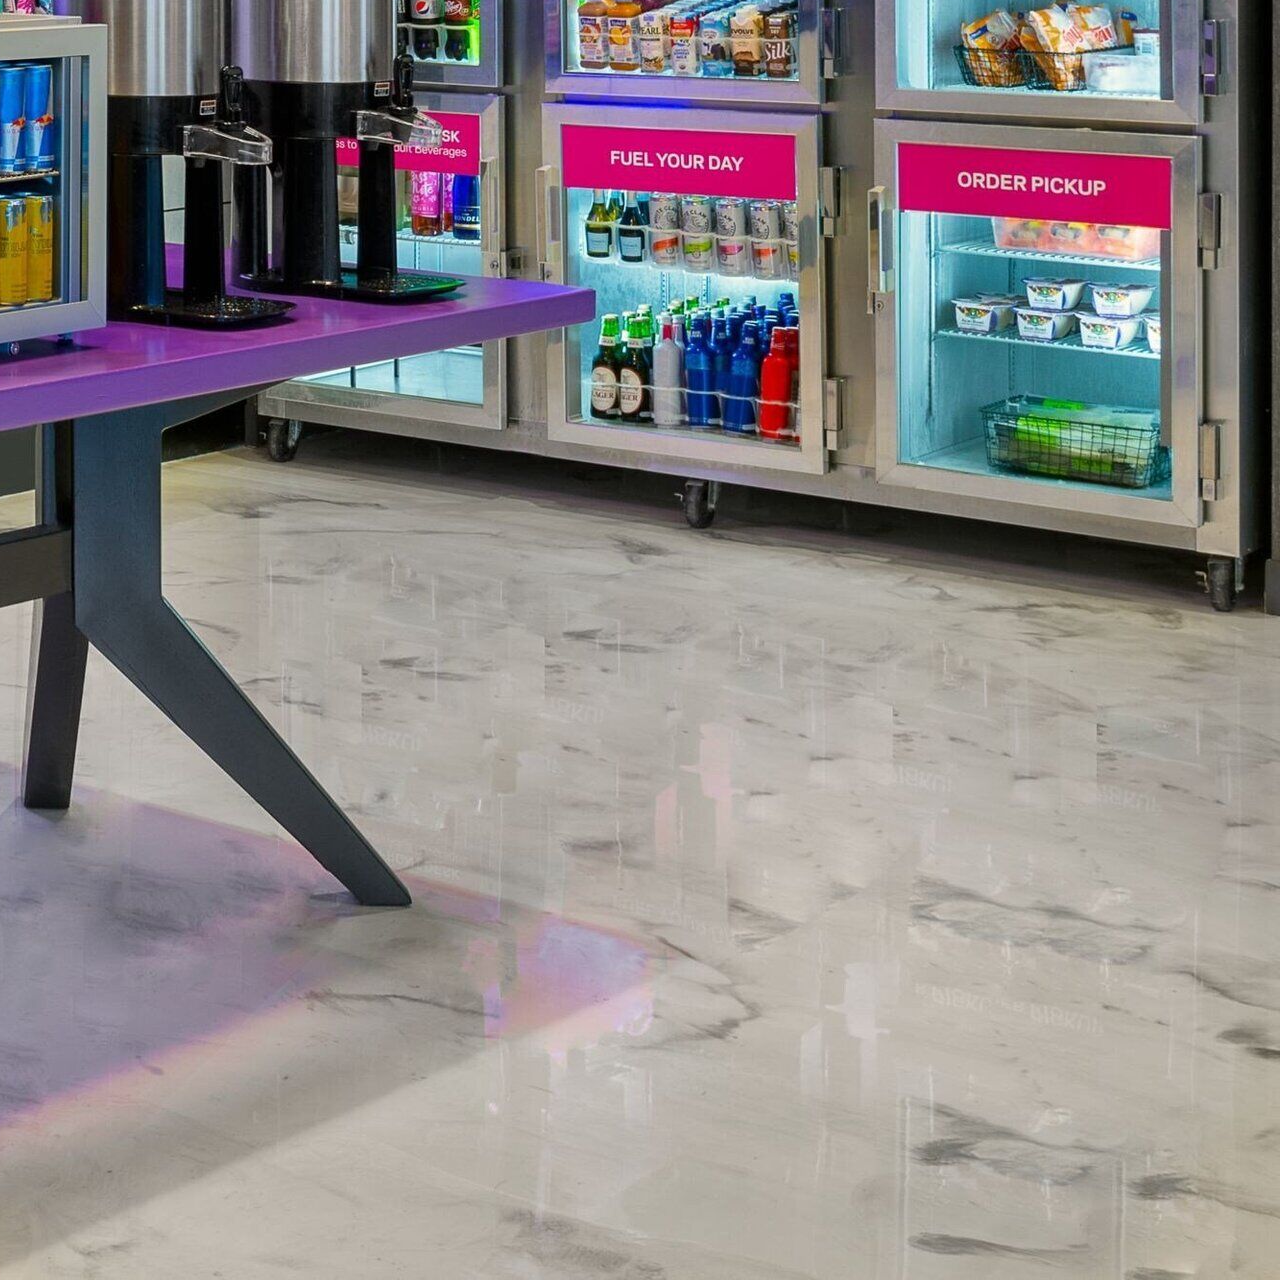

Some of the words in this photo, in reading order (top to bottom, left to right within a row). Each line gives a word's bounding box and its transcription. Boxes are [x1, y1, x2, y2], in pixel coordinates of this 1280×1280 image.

[610, 150, 653, 167] FUEL
[656, 152, 704, 170] YOUR
[708, 155, 744, 172] DAY
[957, 171, 1027, 192] ORDER
[1031, 176, 1106, 196] PICKUP
